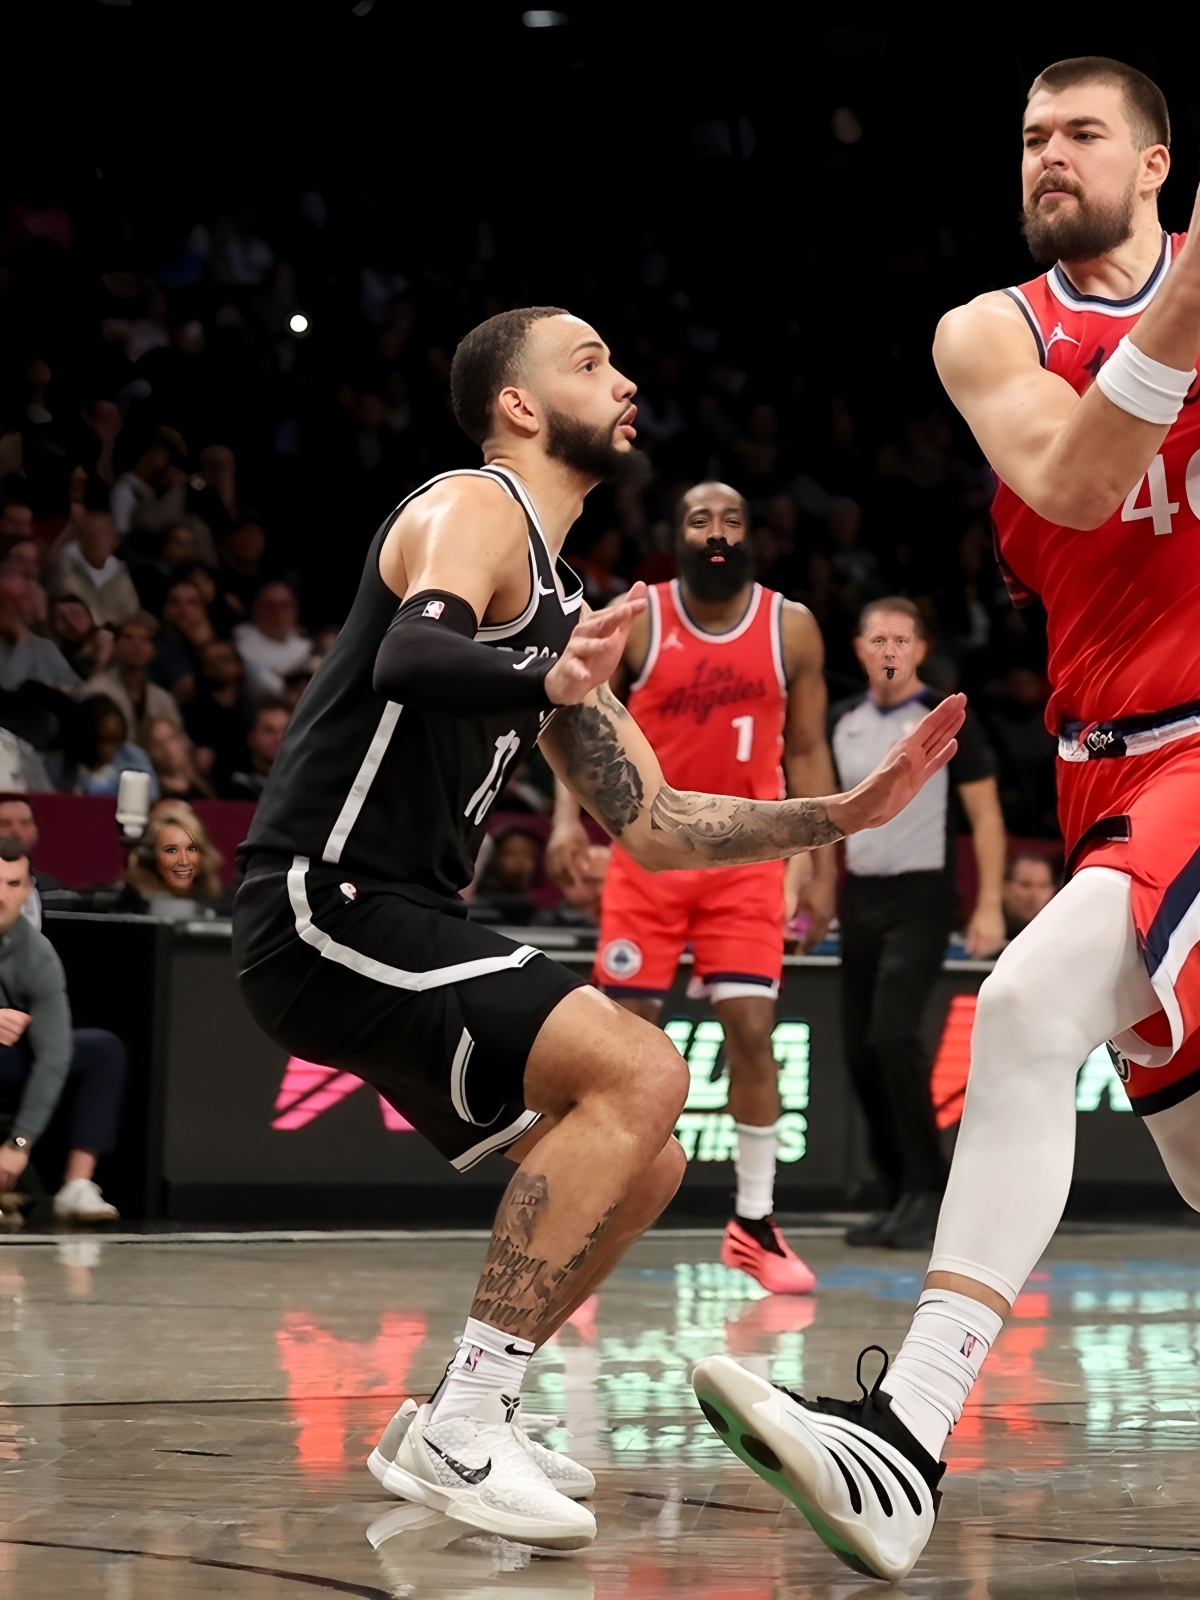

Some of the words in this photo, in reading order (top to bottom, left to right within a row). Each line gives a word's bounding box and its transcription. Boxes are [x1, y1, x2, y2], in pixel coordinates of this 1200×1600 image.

[692, 657, 733, 689] Los
[660, 673, 767, 725] Angeles
[731, 715, 754, 762] 1
[674, 1112, 808, 1163] TIRS
